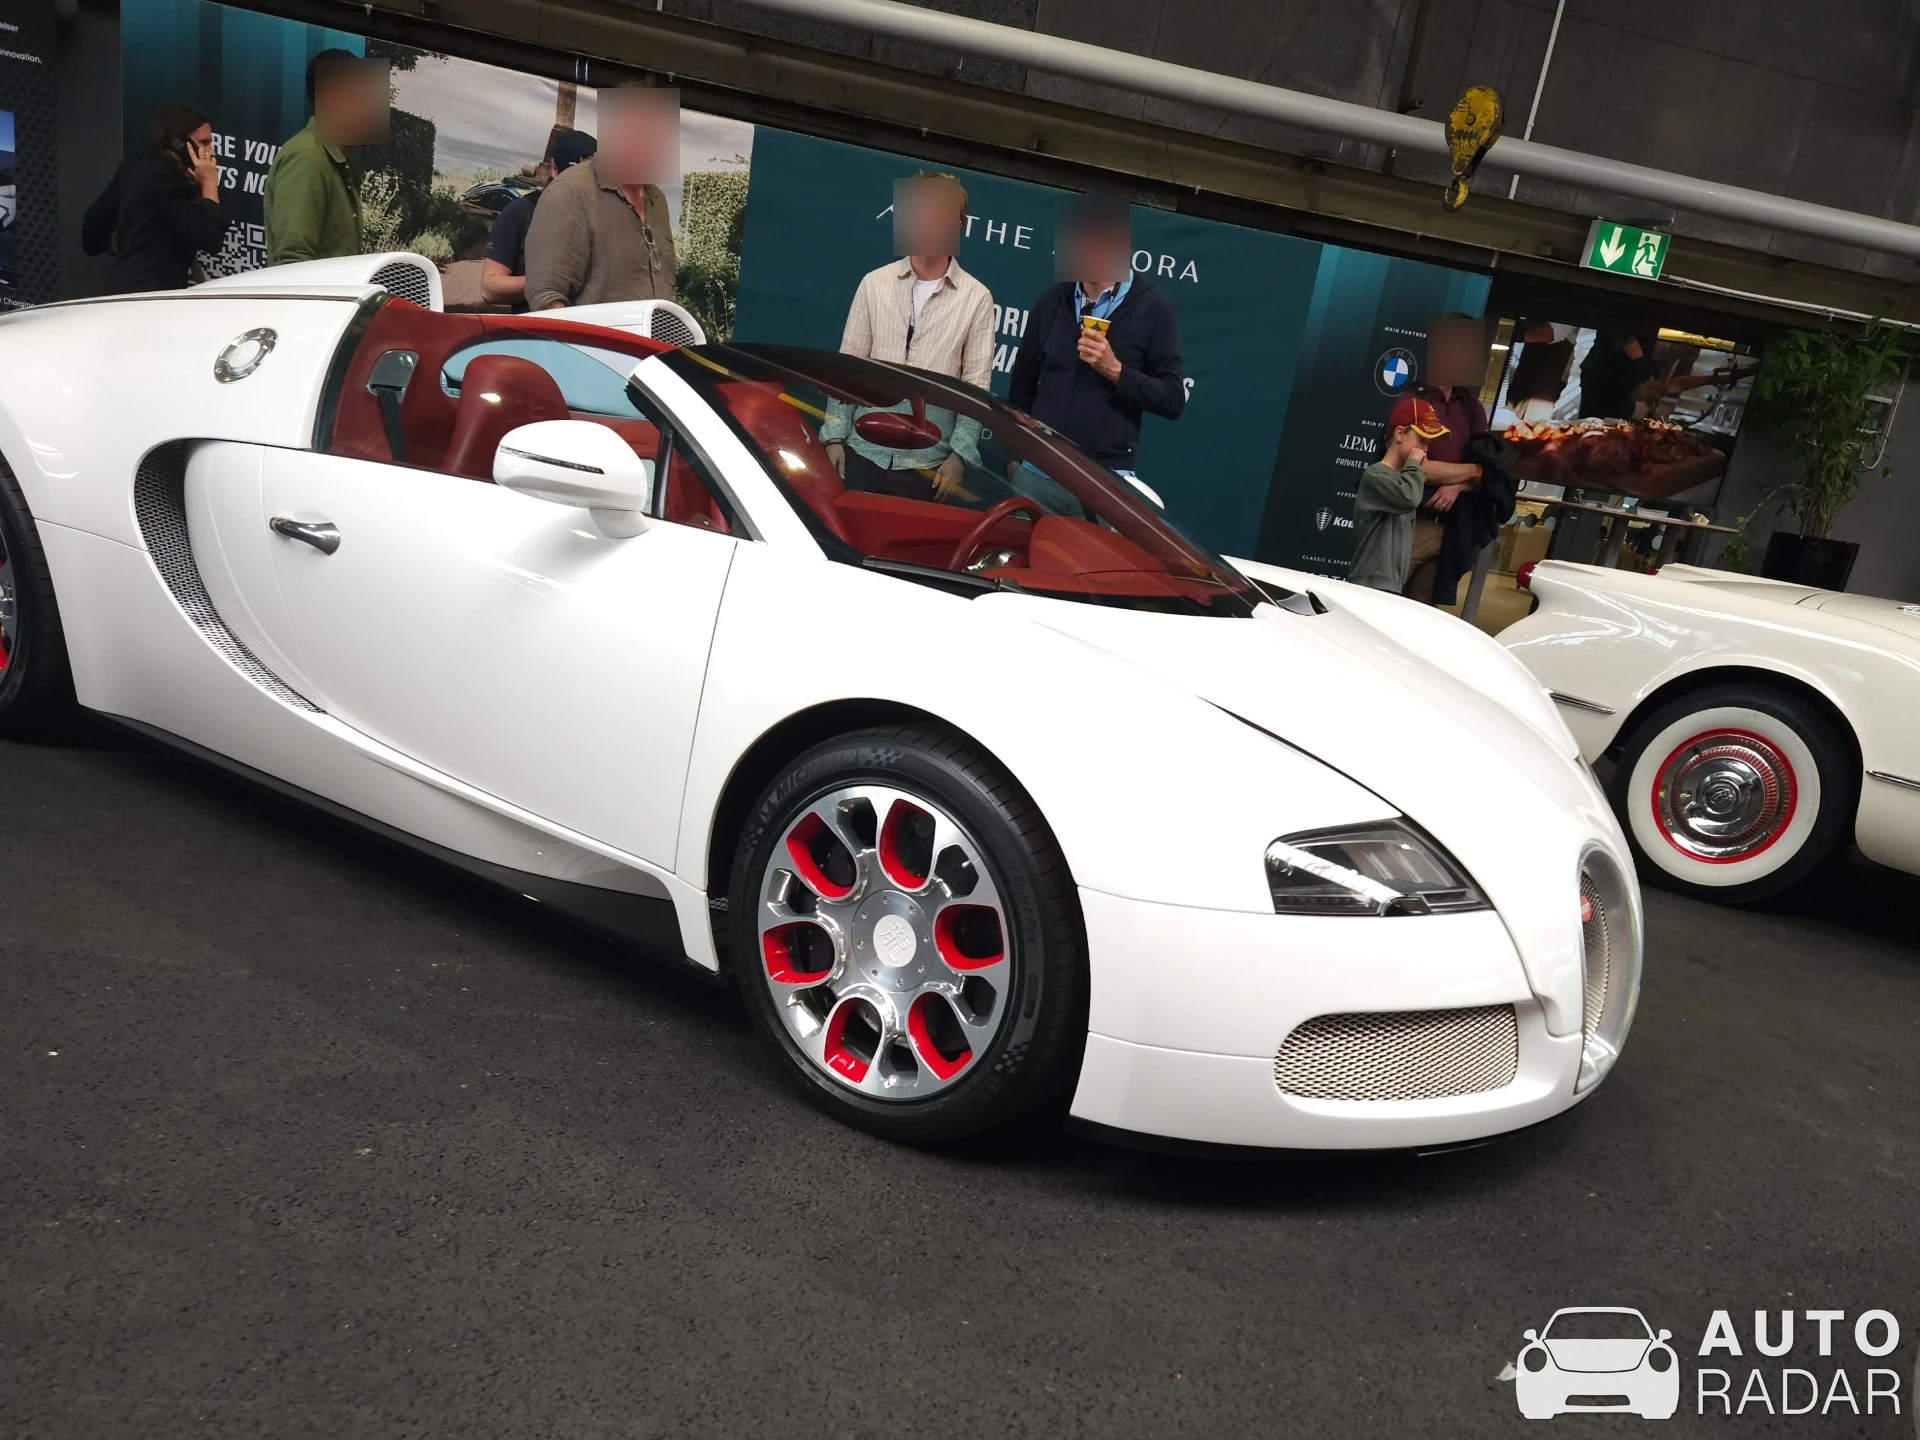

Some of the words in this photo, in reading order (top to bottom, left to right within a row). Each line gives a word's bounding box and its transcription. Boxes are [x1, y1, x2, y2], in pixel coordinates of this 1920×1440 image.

[965, 214, 1034, 250] THE
[1131, 250, 1199, 284] ORA
[1384, 325, 1400, 334] MAIN
[1361, 419, 1377, 427] MAIN
[1335, 457, 1363, 469] PRIVATE
[1302, 554, 1327, 563] CLASSIC
